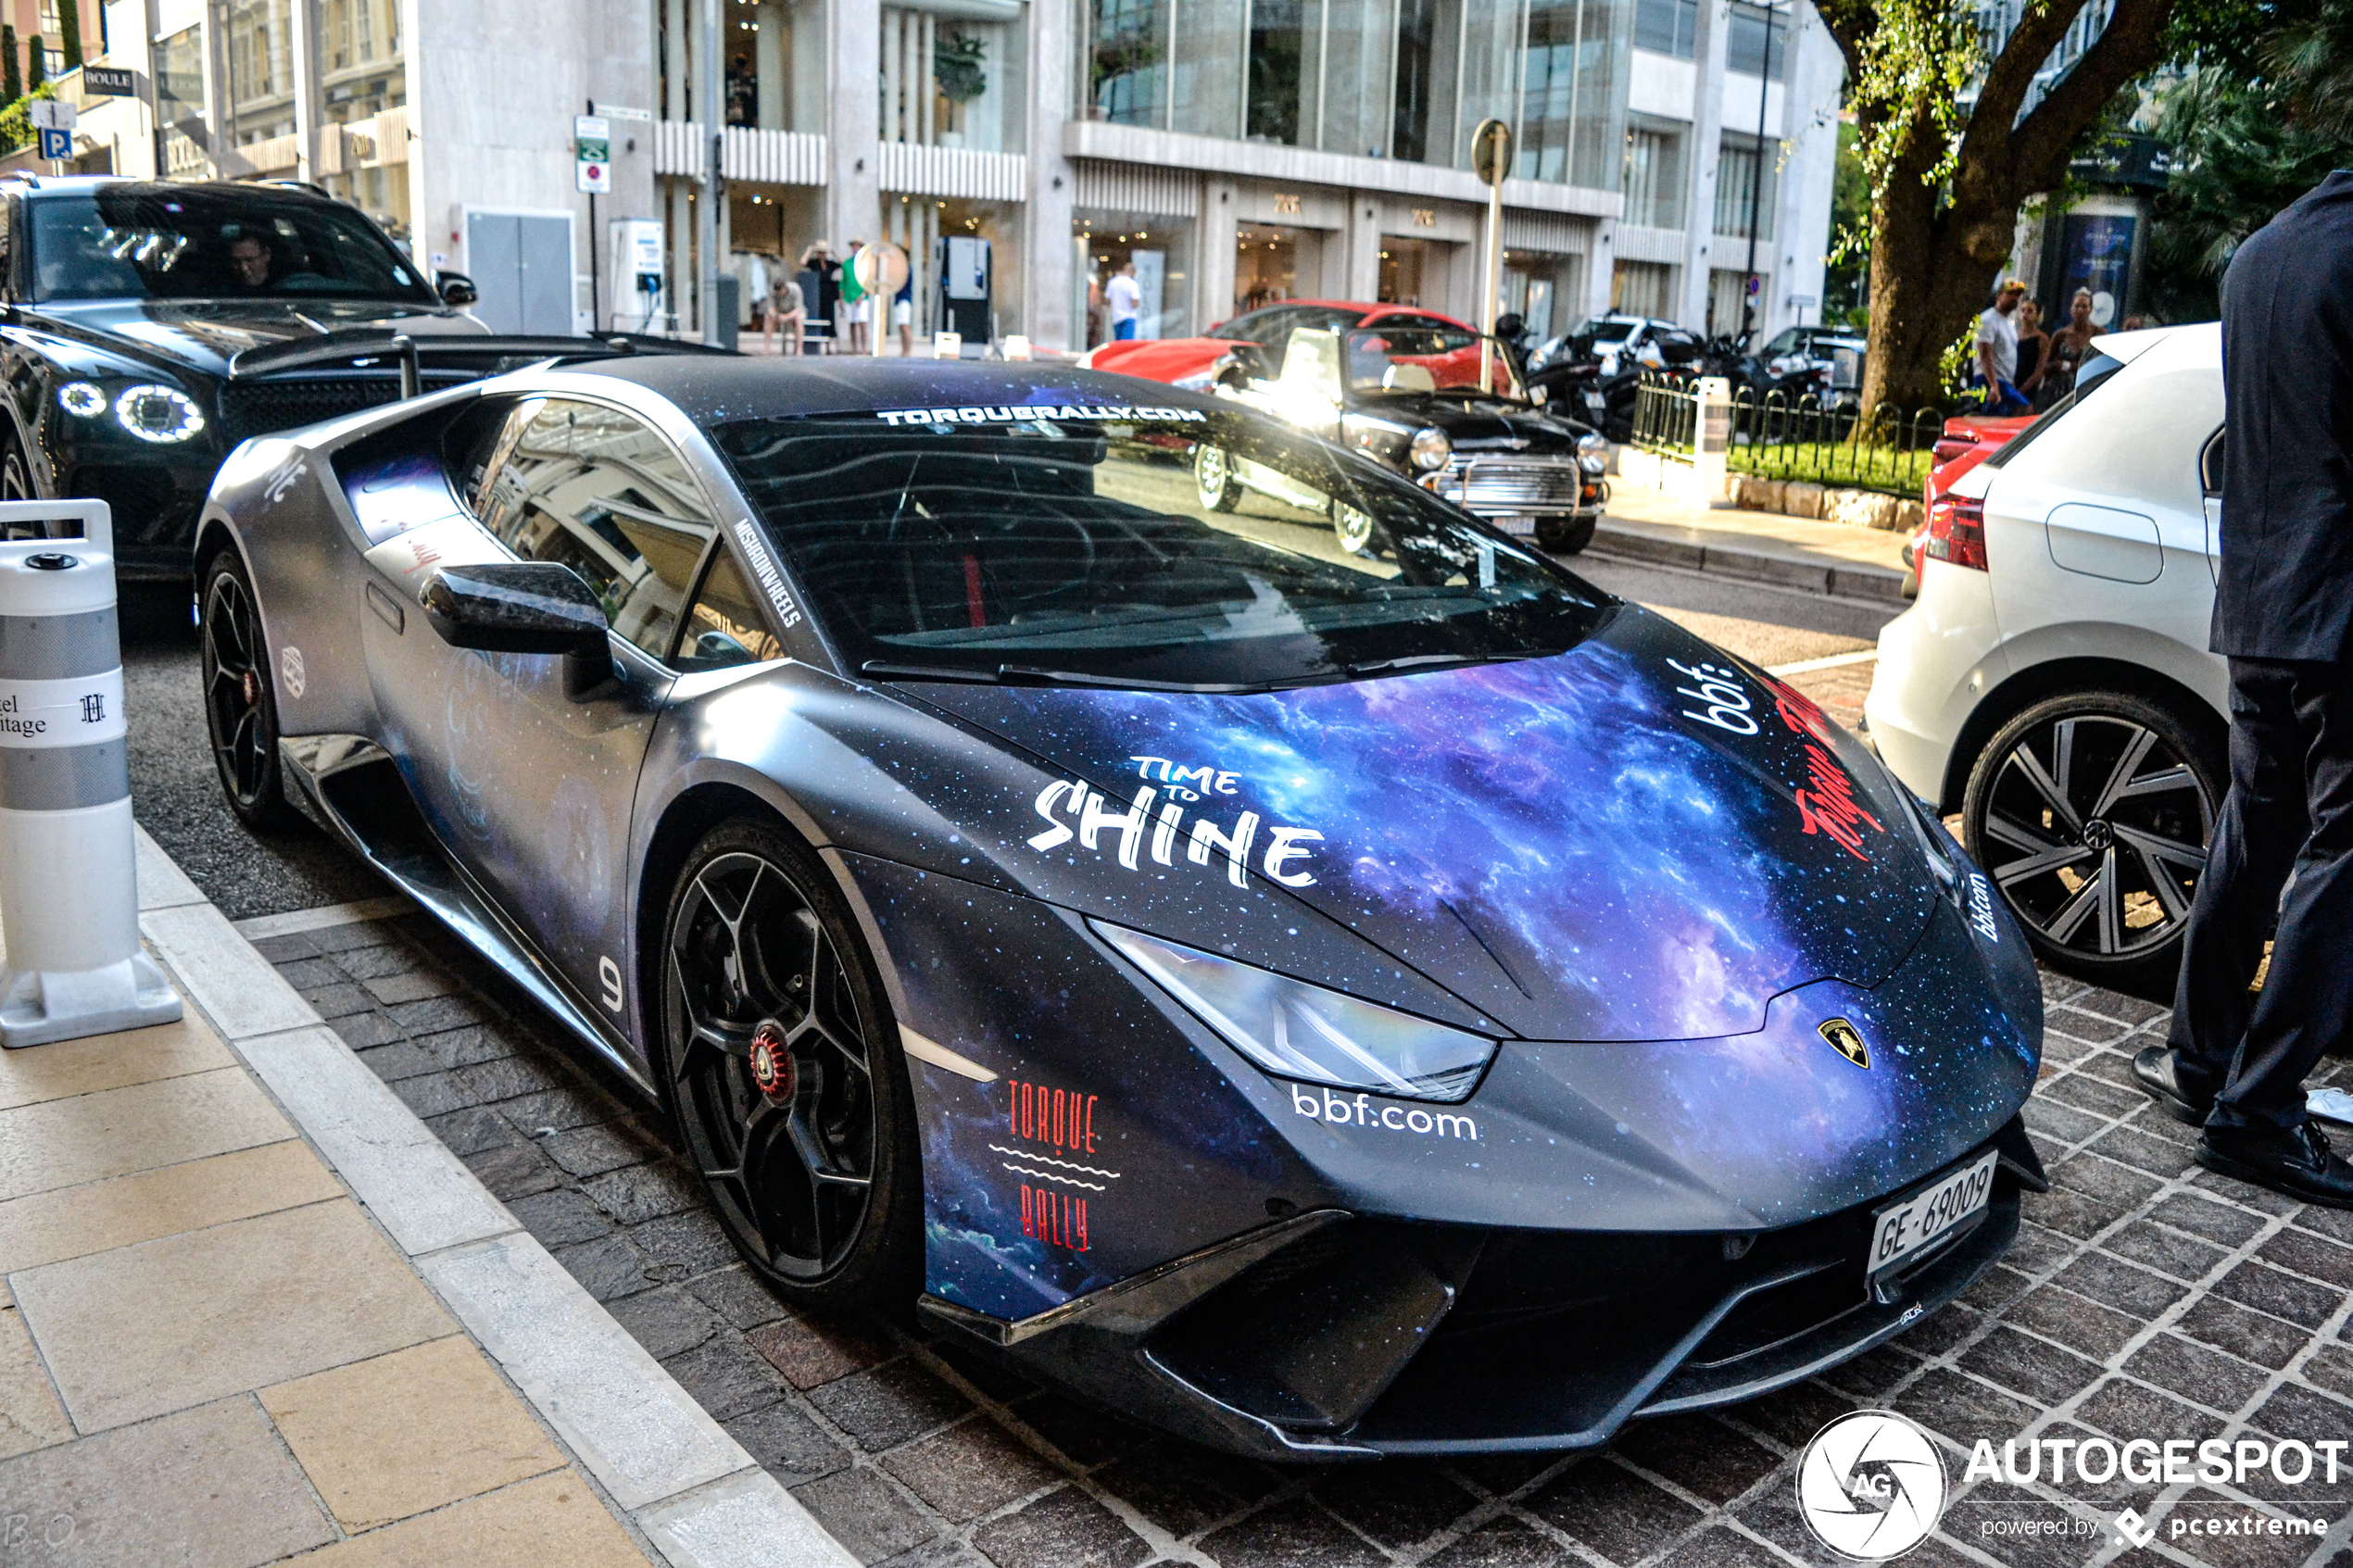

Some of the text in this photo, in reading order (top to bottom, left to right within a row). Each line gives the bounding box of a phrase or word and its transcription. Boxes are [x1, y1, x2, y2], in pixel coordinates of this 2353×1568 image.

[51, 133, 65, 156] P
[877, 405, 1207, 426] TORQUERALLY.COM
[1129, 756, 1242, 796] TIME
[1163, 784, 1200, 802] TO
[1026, 779, 1326, 890] SHINE
[1969, 872, 1998, 943] bbf.com
[598, 955, 623, 1012] 9
[1008, 1079, 1099, 1157] TORQUE
[1291, 1084, 1478, 1141] bbf.com
[1020, 1184, 1088, 1252] RALLY
